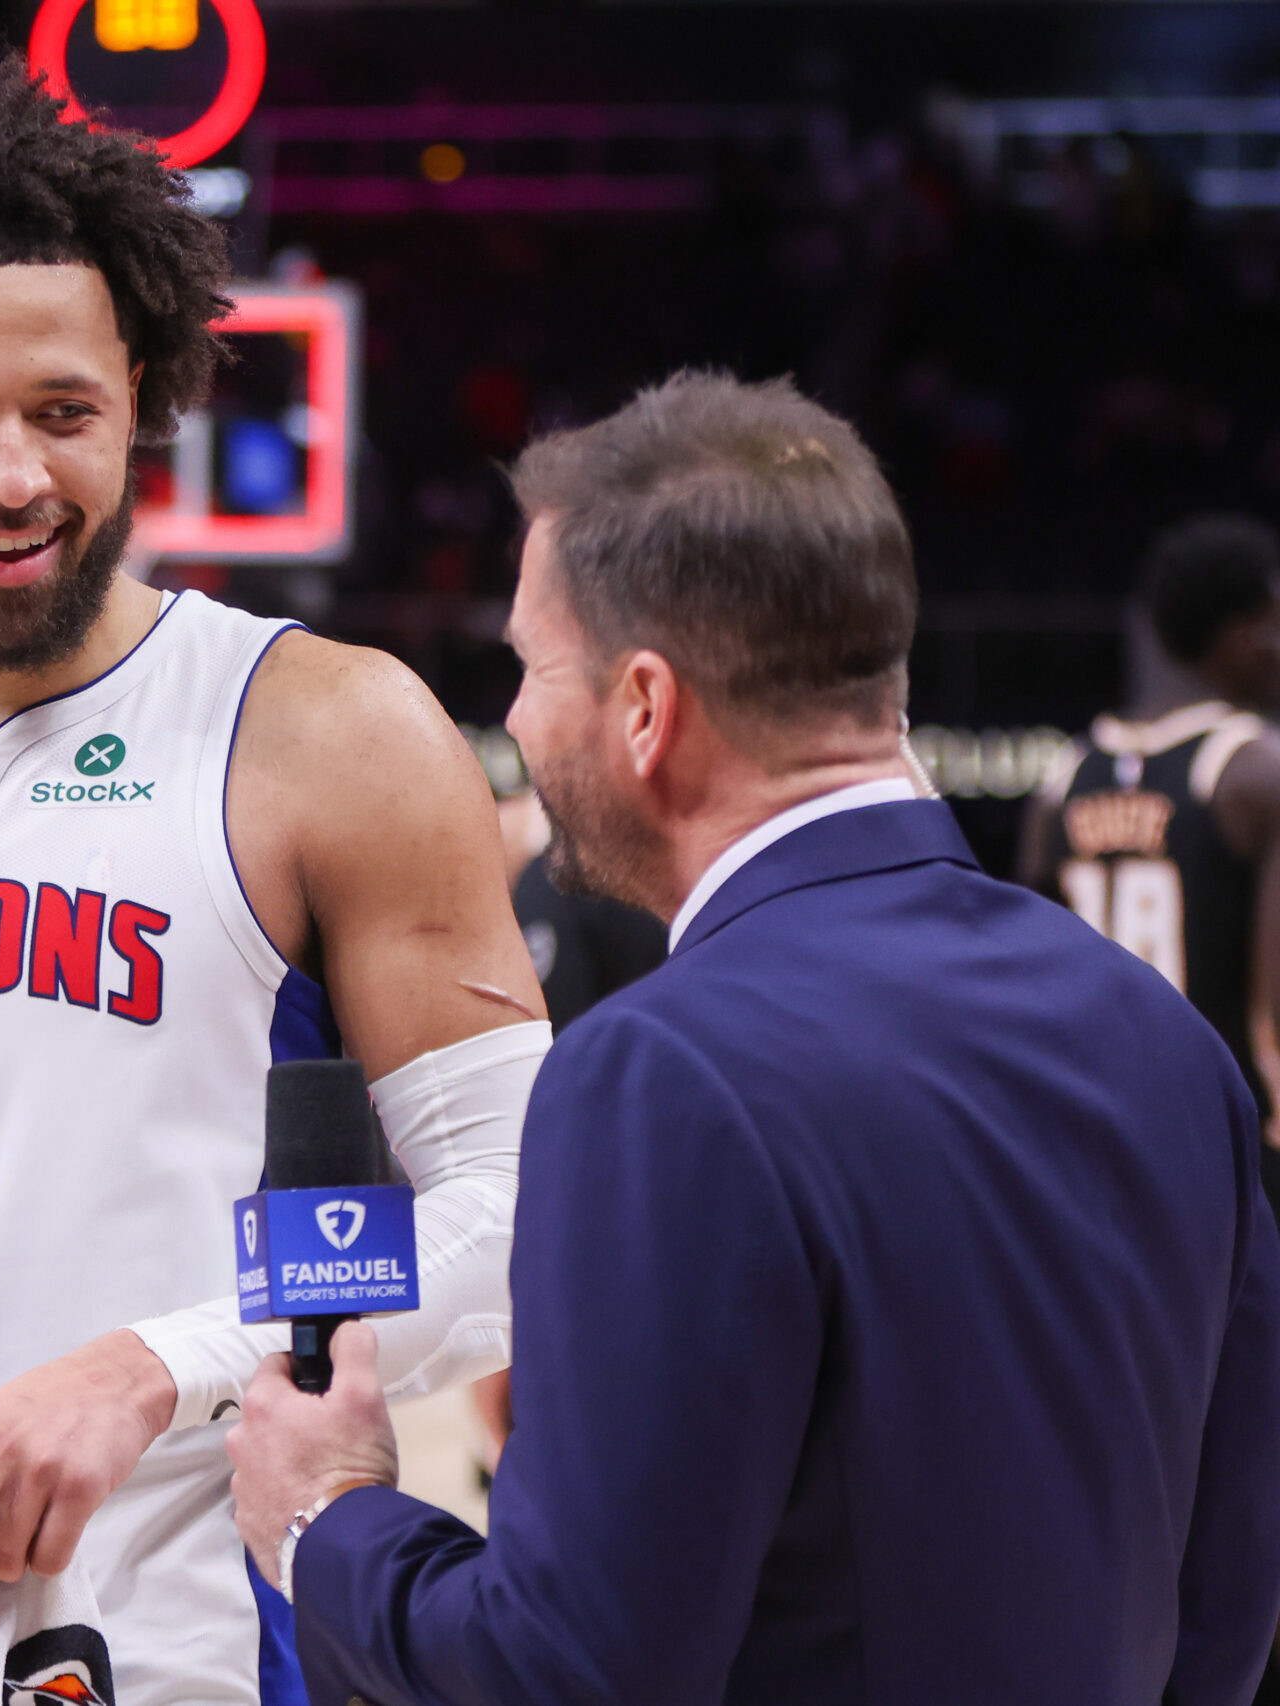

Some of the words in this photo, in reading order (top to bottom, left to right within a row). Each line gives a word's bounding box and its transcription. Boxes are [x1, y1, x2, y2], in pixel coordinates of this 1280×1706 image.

[30, 781, 155, 803] StockX
[282, 1259, 407, 1286] FANDUEL
[283, 1288, 337, 1303] SPORTS
[339, 1284, 407, 1300] NETWORK
